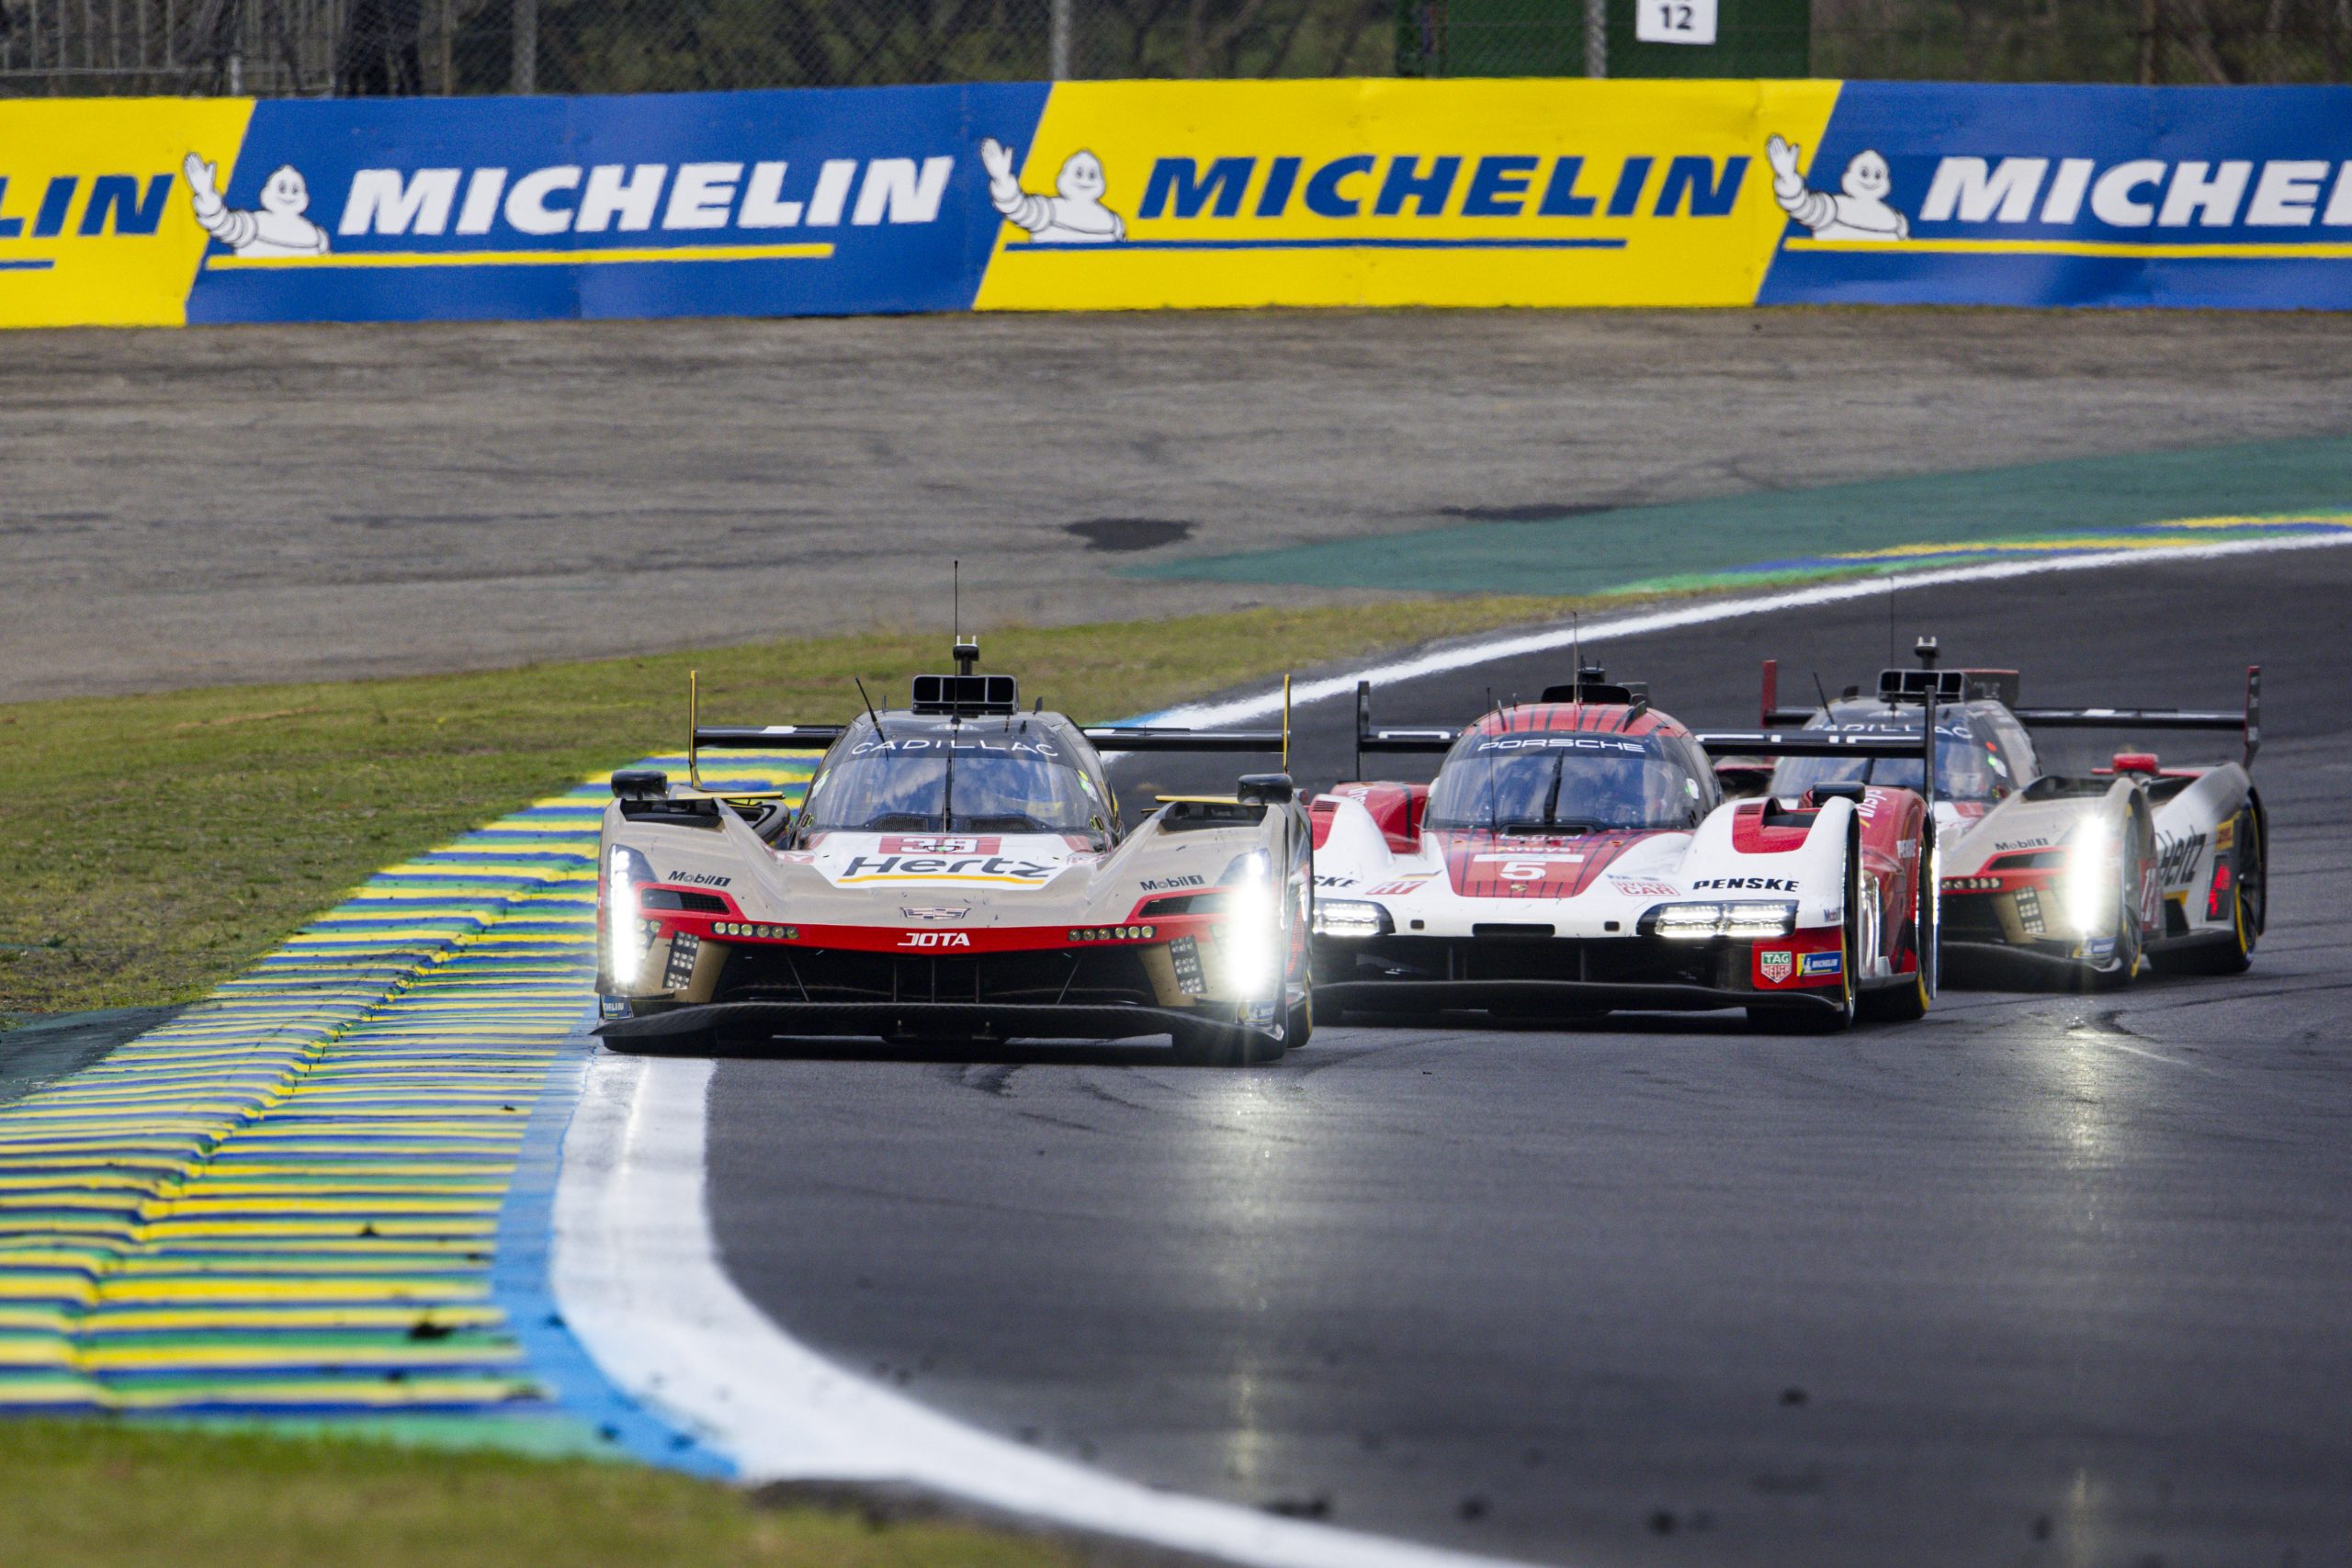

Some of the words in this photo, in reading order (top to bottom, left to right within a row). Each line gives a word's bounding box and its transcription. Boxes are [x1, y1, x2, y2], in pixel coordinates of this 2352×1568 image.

[1659, 5, 1692, 29] 12
[338, 156, 955, 236] MICHELIN
[1138, 156, 1753, 219] MICHELIN
[852, 739, 1059, 757] CADILLAC
[1477, 739, 1646, 752] PORSCHE
[842, 856, 1057, 878] Hertz
[1499, 862, 1547, 880] 5
[1692, 877, 1800, 892] PENSKE
[898, 932, 971, 947] JOTA
[1765, 954, 1790, 964] TAG
